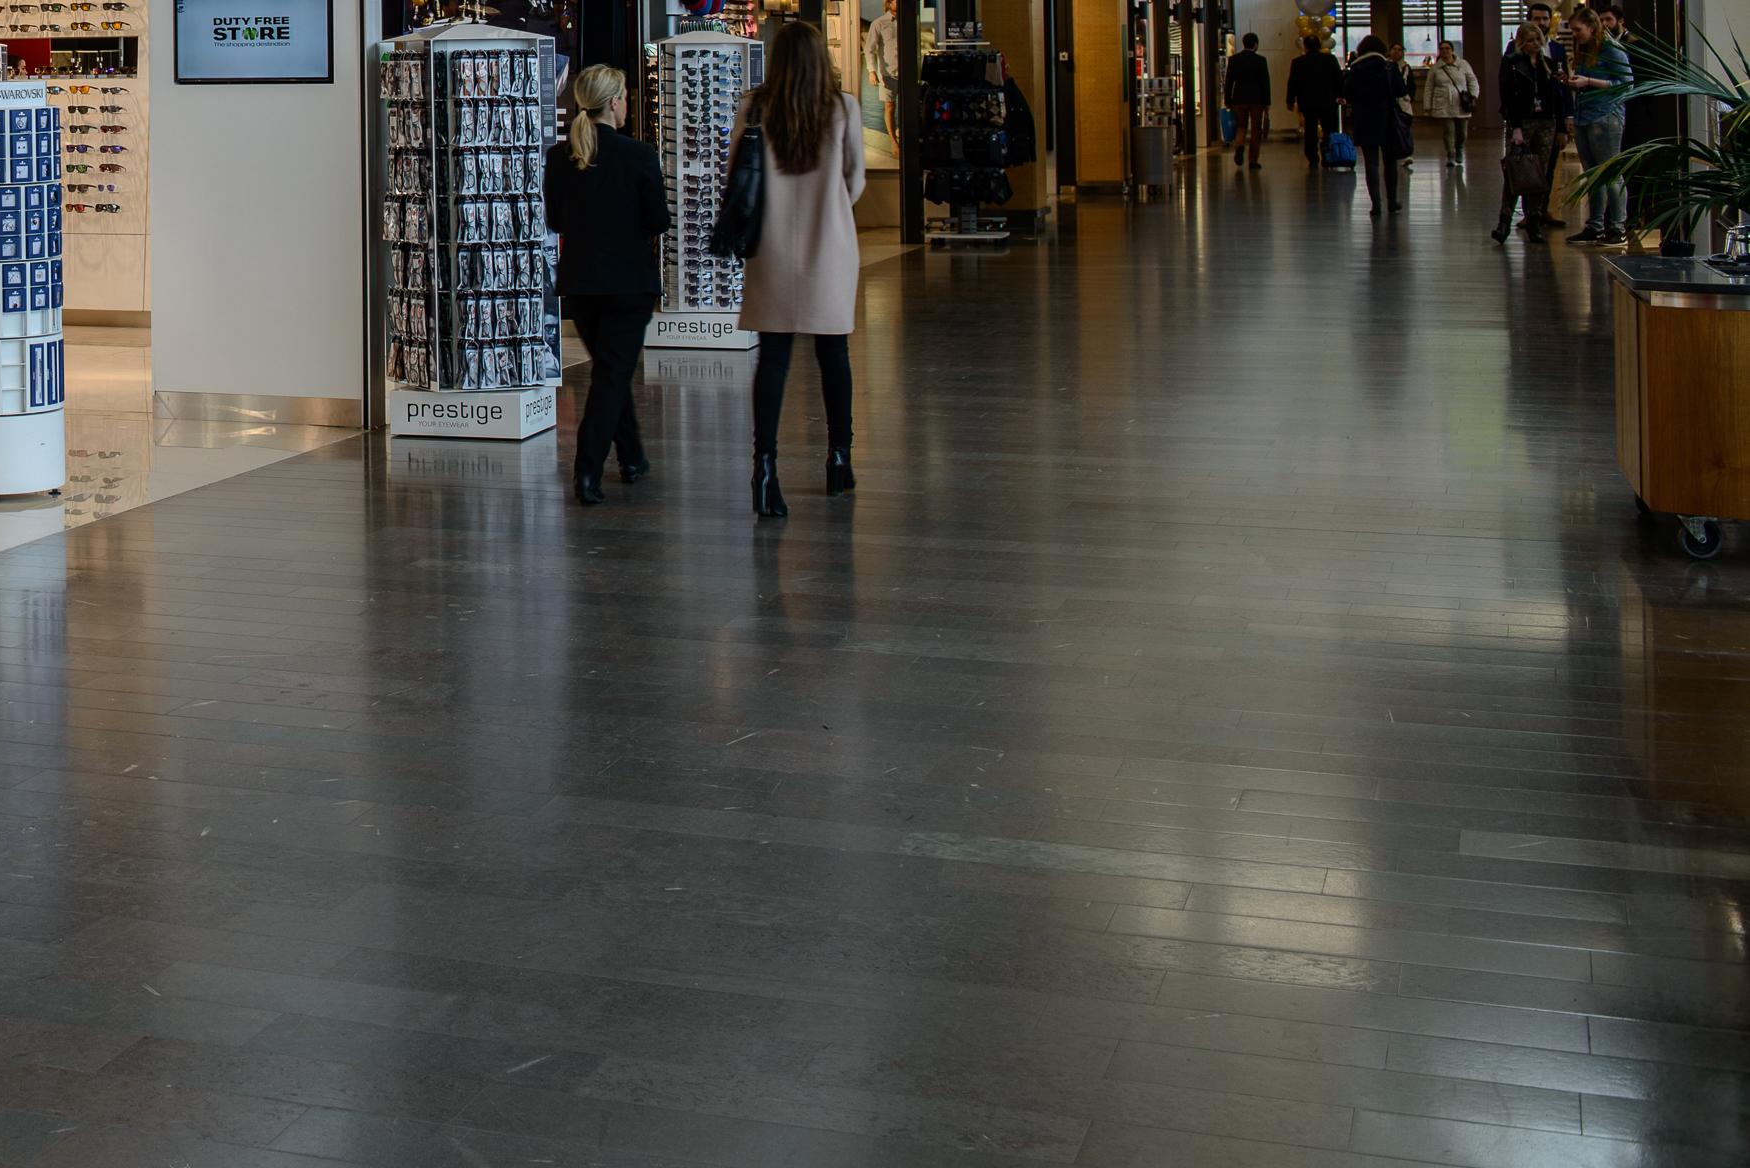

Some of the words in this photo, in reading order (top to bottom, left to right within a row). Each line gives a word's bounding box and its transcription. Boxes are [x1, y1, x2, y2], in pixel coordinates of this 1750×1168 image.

[213, 17, 250, 26] DUTY
[254, 16, 290, 25] FREE
[657, 320, 733, 338] prestige
[407, 402, 503, 425] prestige
[525, 394, 552, 423] prestige
